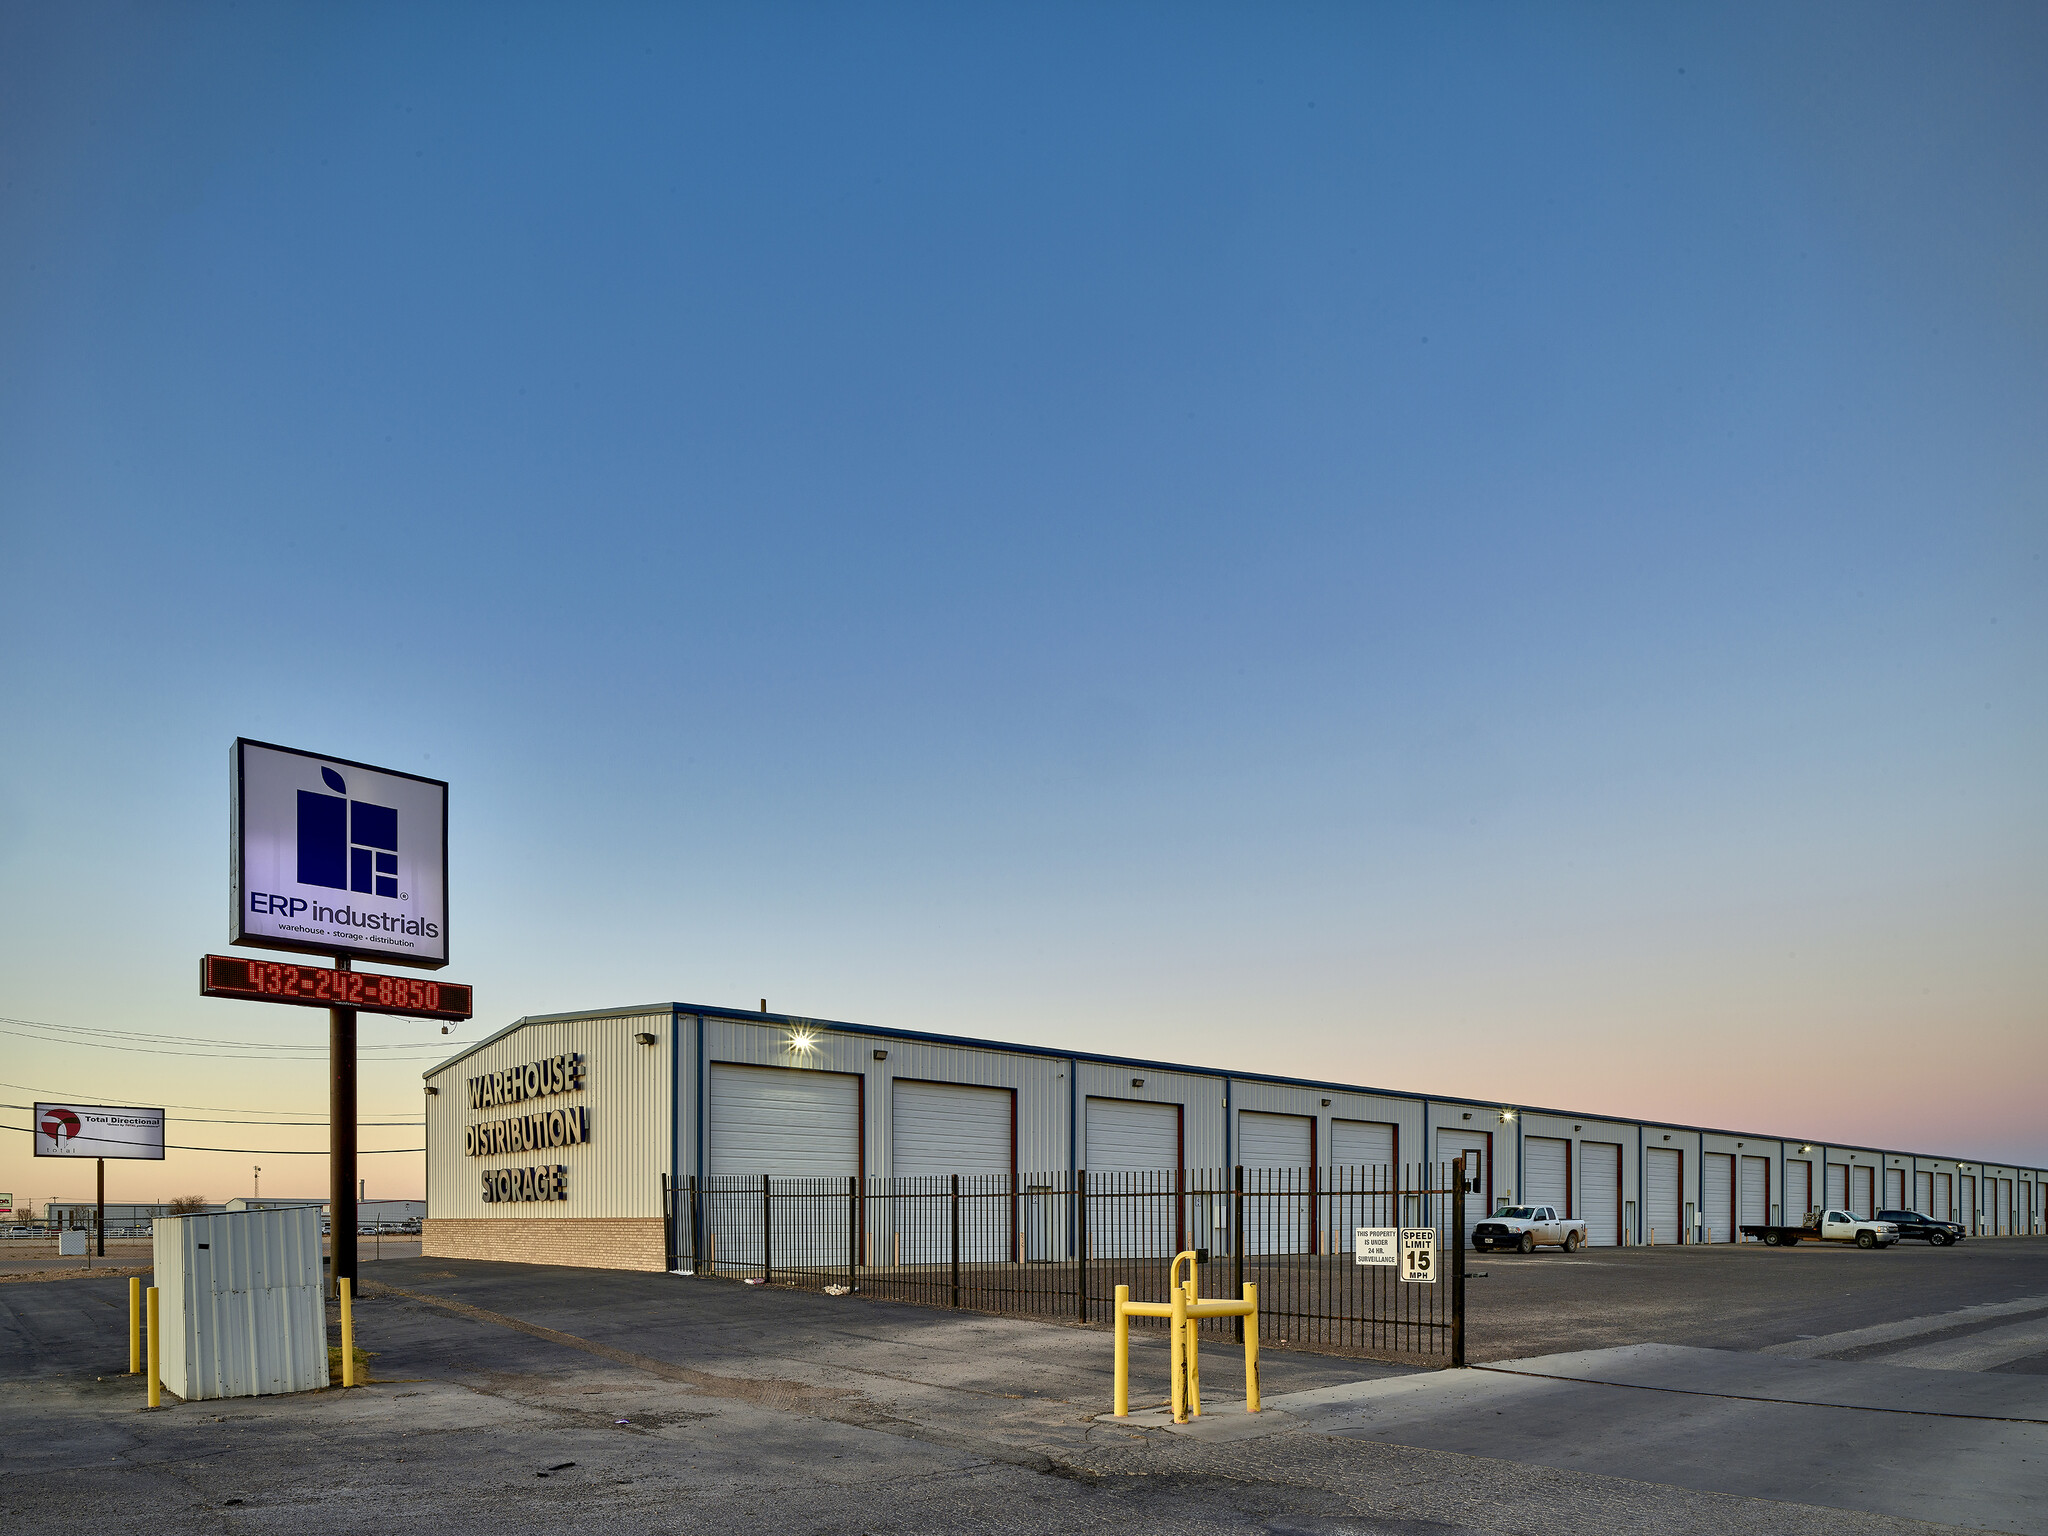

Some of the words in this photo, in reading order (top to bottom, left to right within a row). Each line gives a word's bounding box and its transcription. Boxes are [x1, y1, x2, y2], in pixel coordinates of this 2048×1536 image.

[250, 891, 308, 918] ERP
[312, 900, 439, 938] industrials
[278, 922, 325, 936] warehouse
[332, 930, 364, 941] storage
[369, 935, 415, 948] distribution
[248, 961, 440, 1010] 432-242-8850
[466, 1052, 579, 1110] WAREHOUSE
[111, 1117, 160, 1125] Directional
[465, 1106, 584, 1157] DISTRIBUTION
[482, 1164, 564, 1203] STORAGE
[1407, 1251, 1431, 1270] 15
